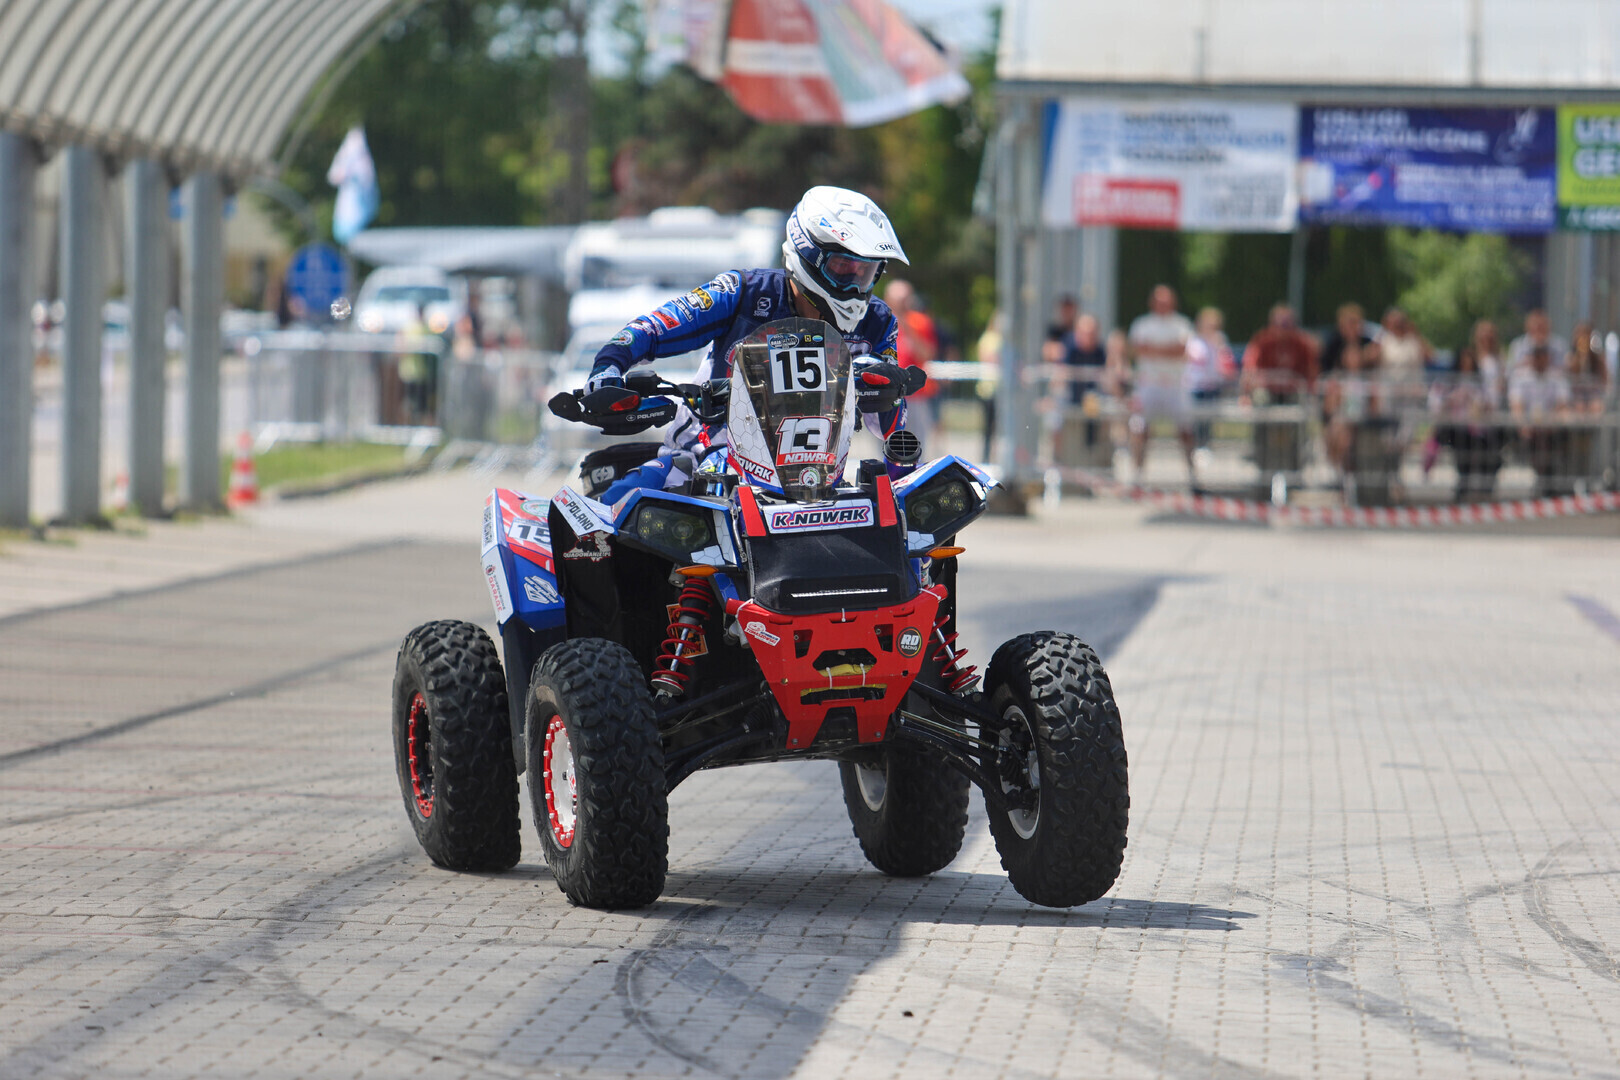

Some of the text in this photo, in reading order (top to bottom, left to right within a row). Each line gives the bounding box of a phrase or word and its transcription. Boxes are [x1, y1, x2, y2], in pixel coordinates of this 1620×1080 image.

[776, 350, 822, 390] 15
[636, 410, 665, 420] POLARIS
[783, 452, 830, 464] NOWAK
[565, 500, 595, 531] POLAND
[774, 507, 868, 528] K.NOWAK
[517, 524, 551, 546] 15
[488, 576, 503, 612] GARAGE
[901, 633, 920, 646] RD
